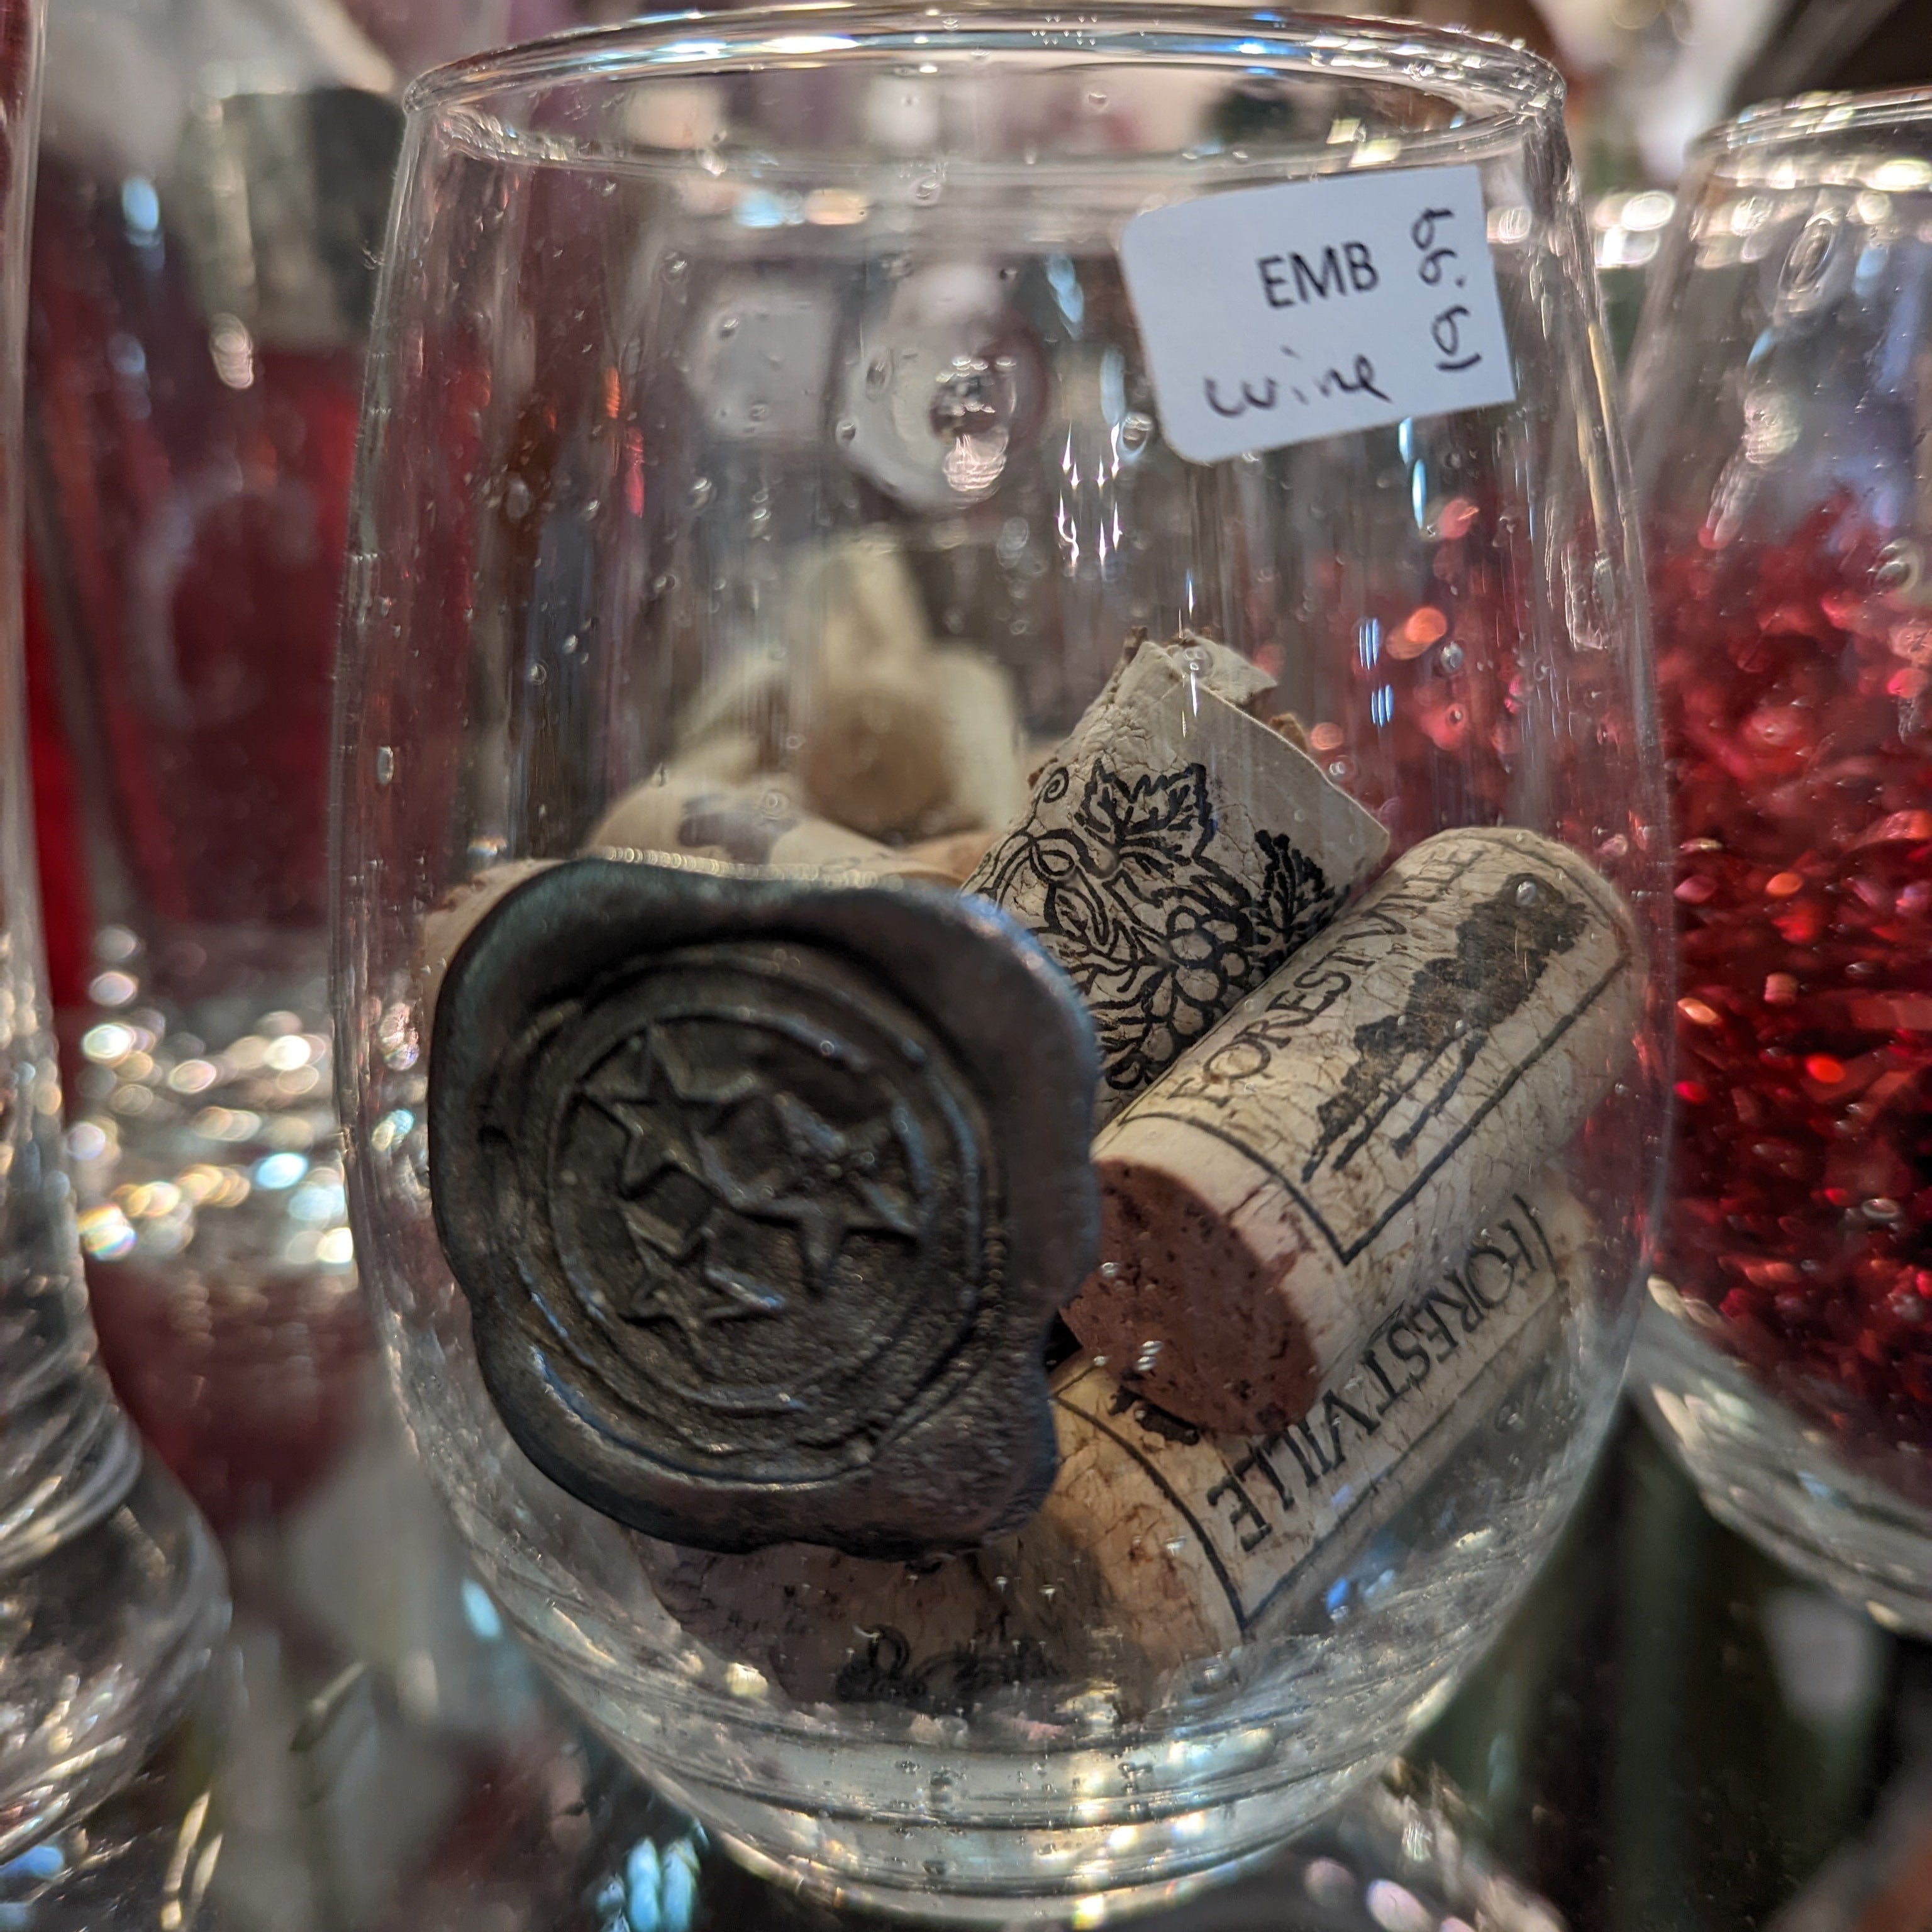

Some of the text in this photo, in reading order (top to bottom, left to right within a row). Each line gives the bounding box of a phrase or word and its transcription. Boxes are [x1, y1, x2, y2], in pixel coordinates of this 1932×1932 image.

[1257, 242, 1379, 309] EMB
[1169, 850, 1485, 1110] FORESTVILLE
[1207, 1219, 1537, 1552] FORESTVILLE
